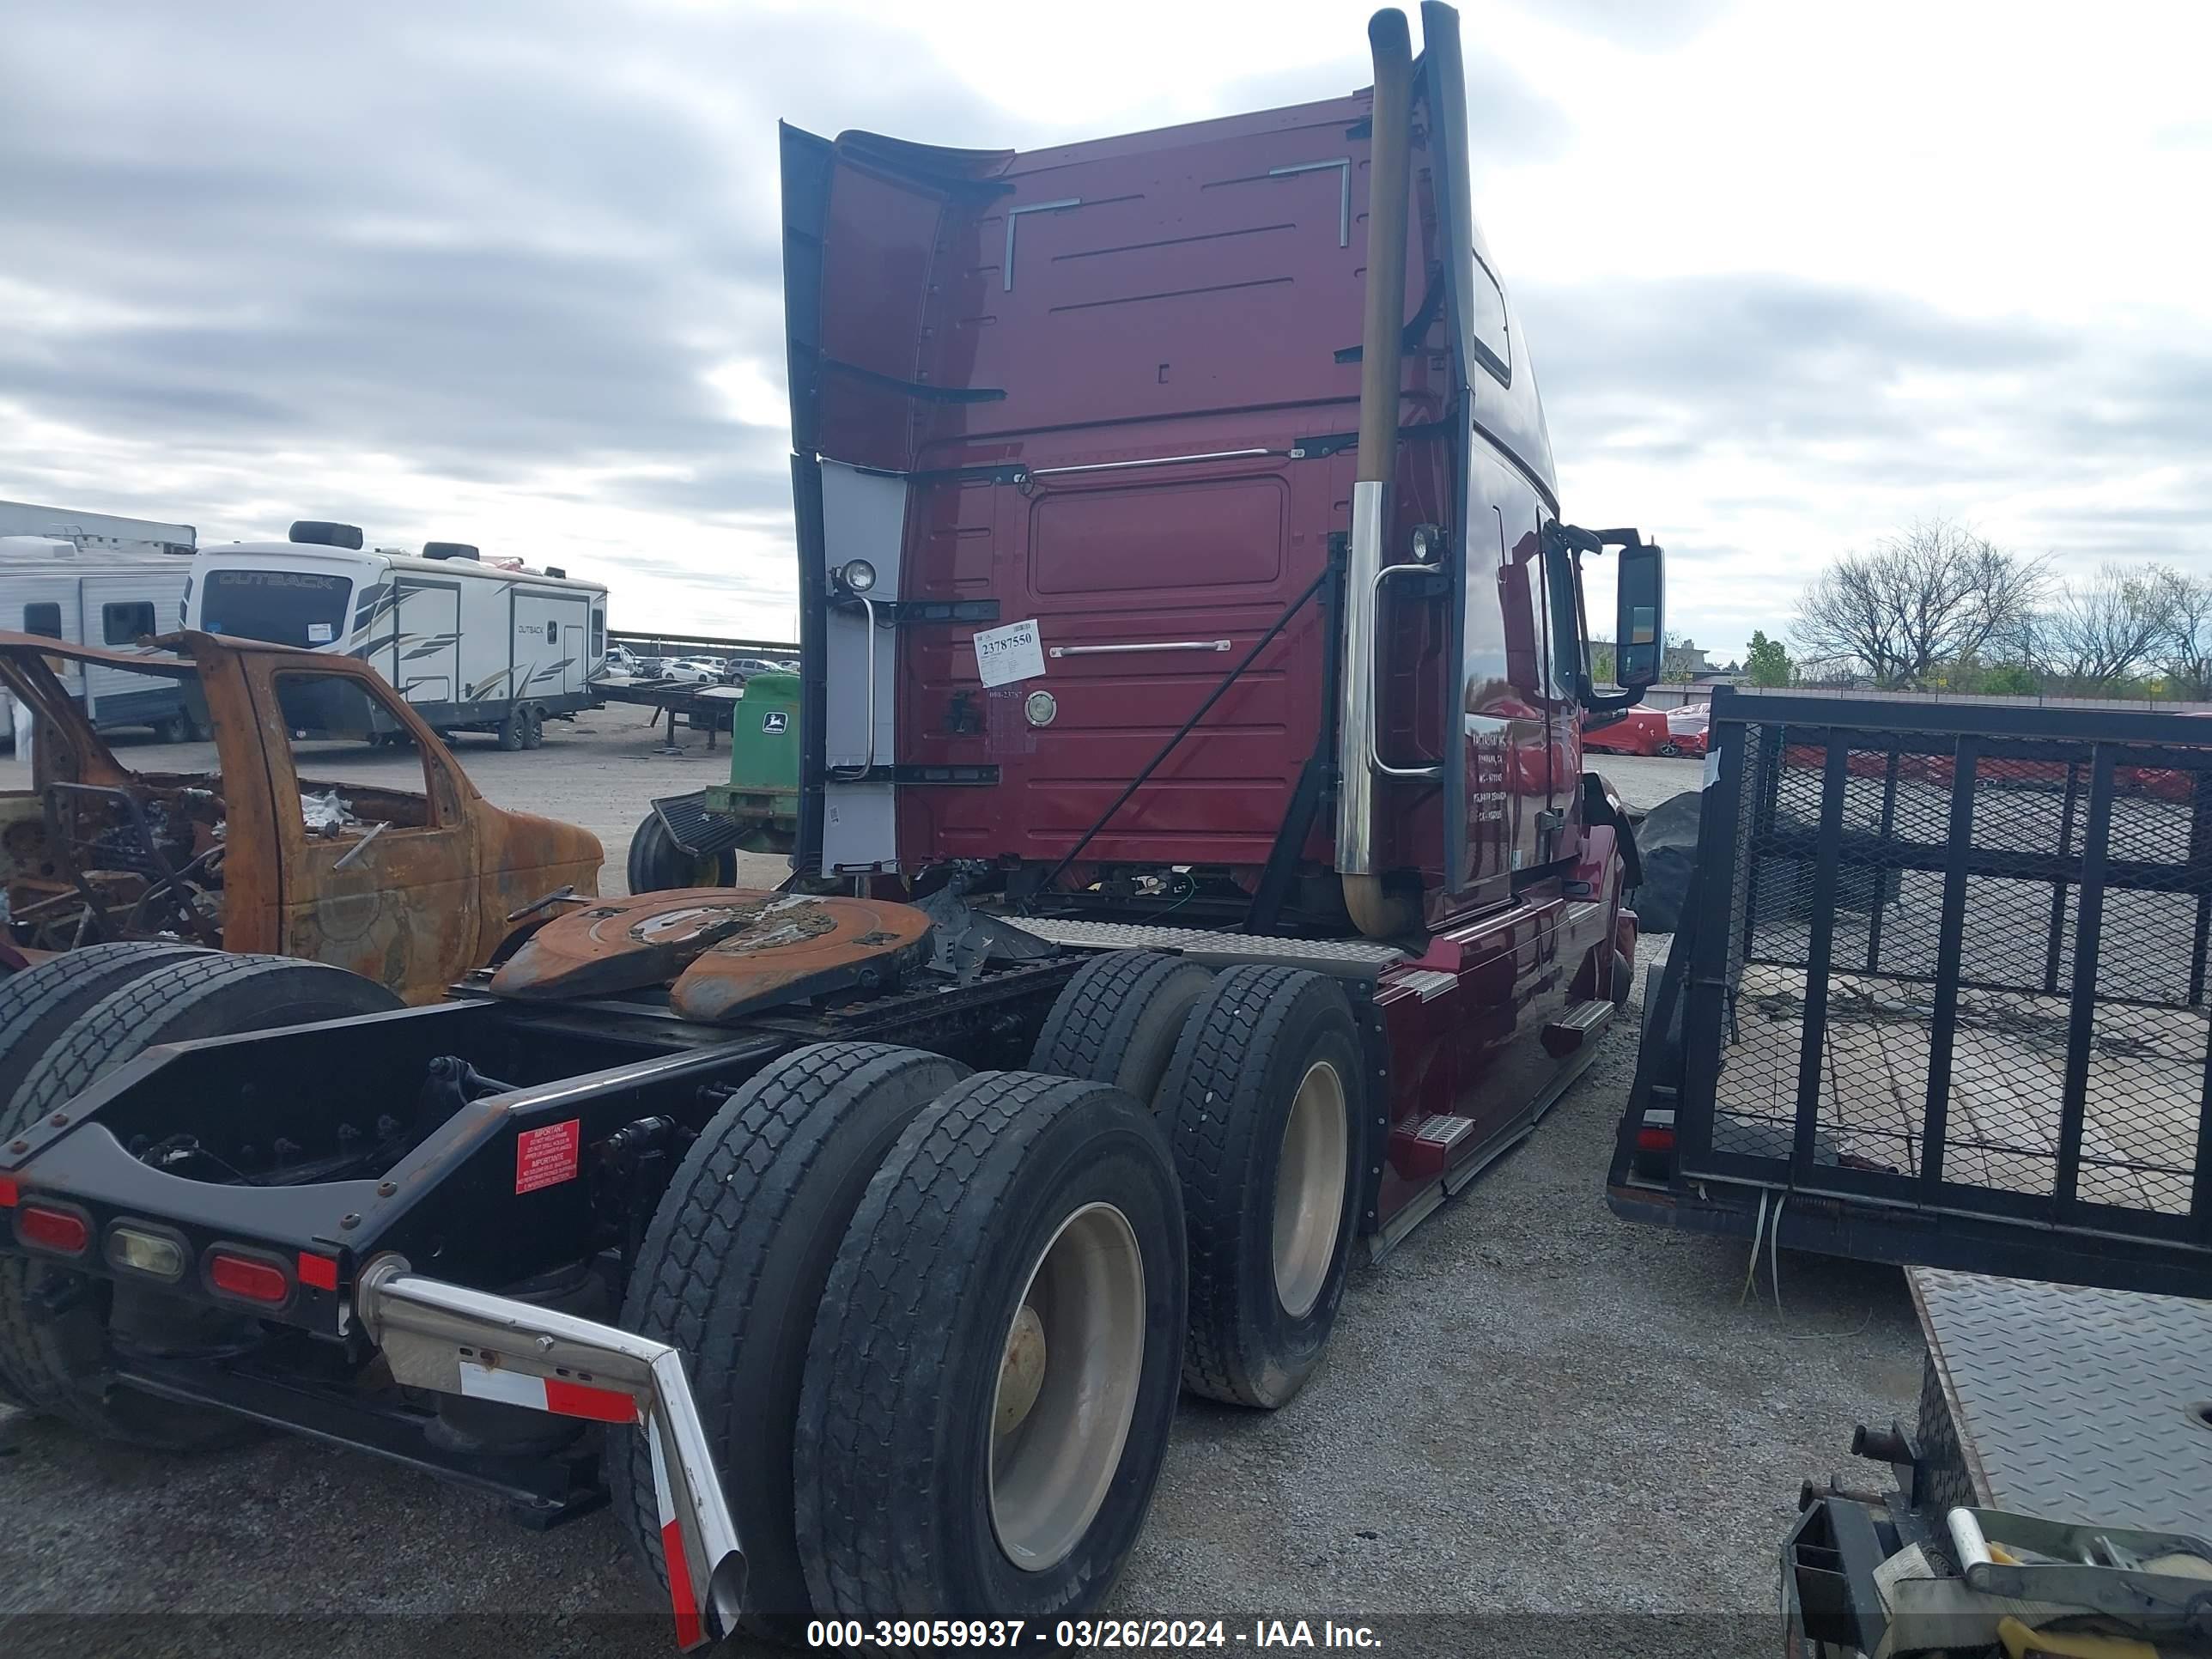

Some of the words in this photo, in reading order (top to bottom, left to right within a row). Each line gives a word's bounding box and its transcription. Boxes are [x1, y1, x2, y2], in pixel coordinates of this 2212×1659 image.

[219, 572, 336, 590] OUTBACK
[518, 625, 544, 634] OUTBACK
[982, 632, 1032, 655] 23787550
[534, 1124, 564, 1138] IMPORTANT
[532, 1152, 564, 1168] IMPORTANTE
